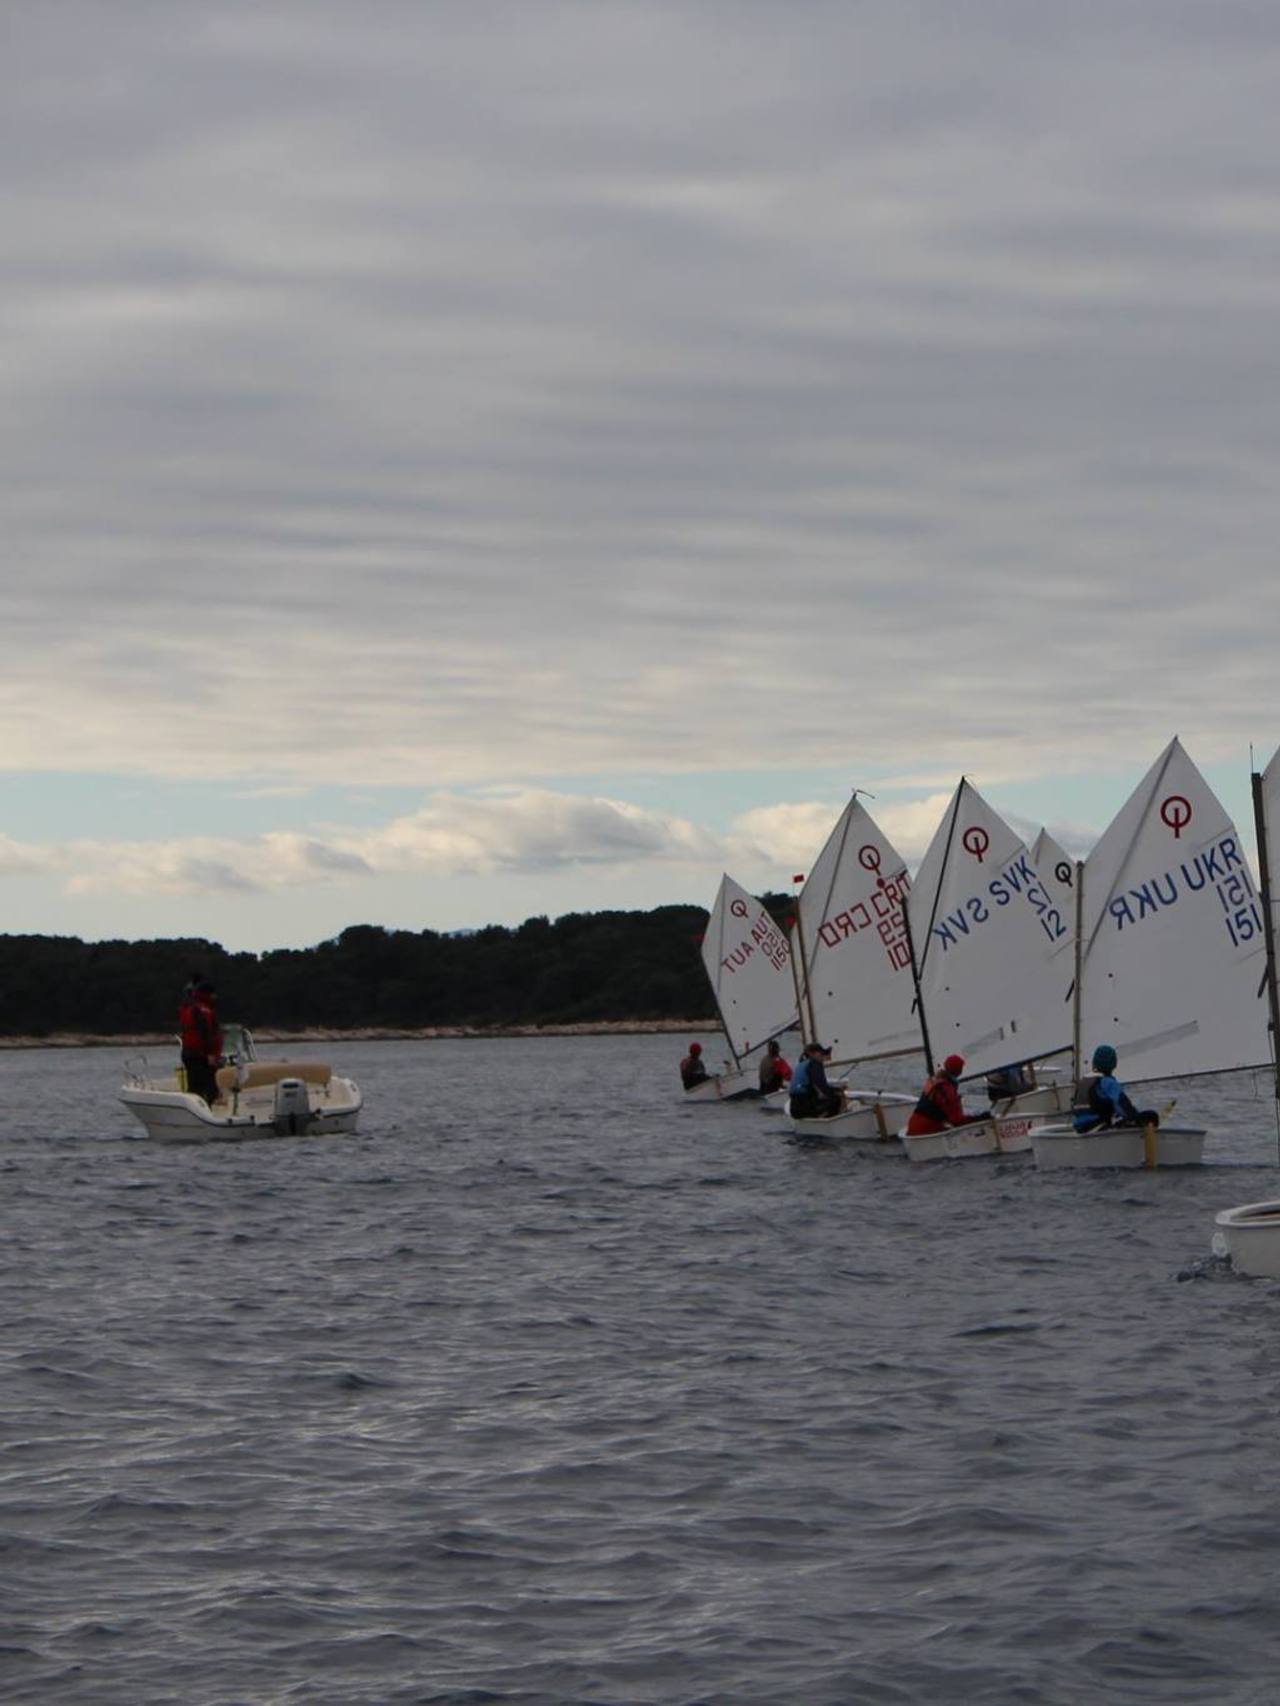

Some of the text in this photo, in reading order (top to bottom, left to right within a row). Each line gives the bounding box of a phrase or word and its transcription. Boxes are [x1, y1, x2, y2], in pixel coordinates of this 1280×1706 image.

[988, 855, 1037, 906] SVK
[1181, 838, 1242, 890] UKR
[1040, 909, 1067, 942] 12
[1226, 904, 1263, 948] 151
